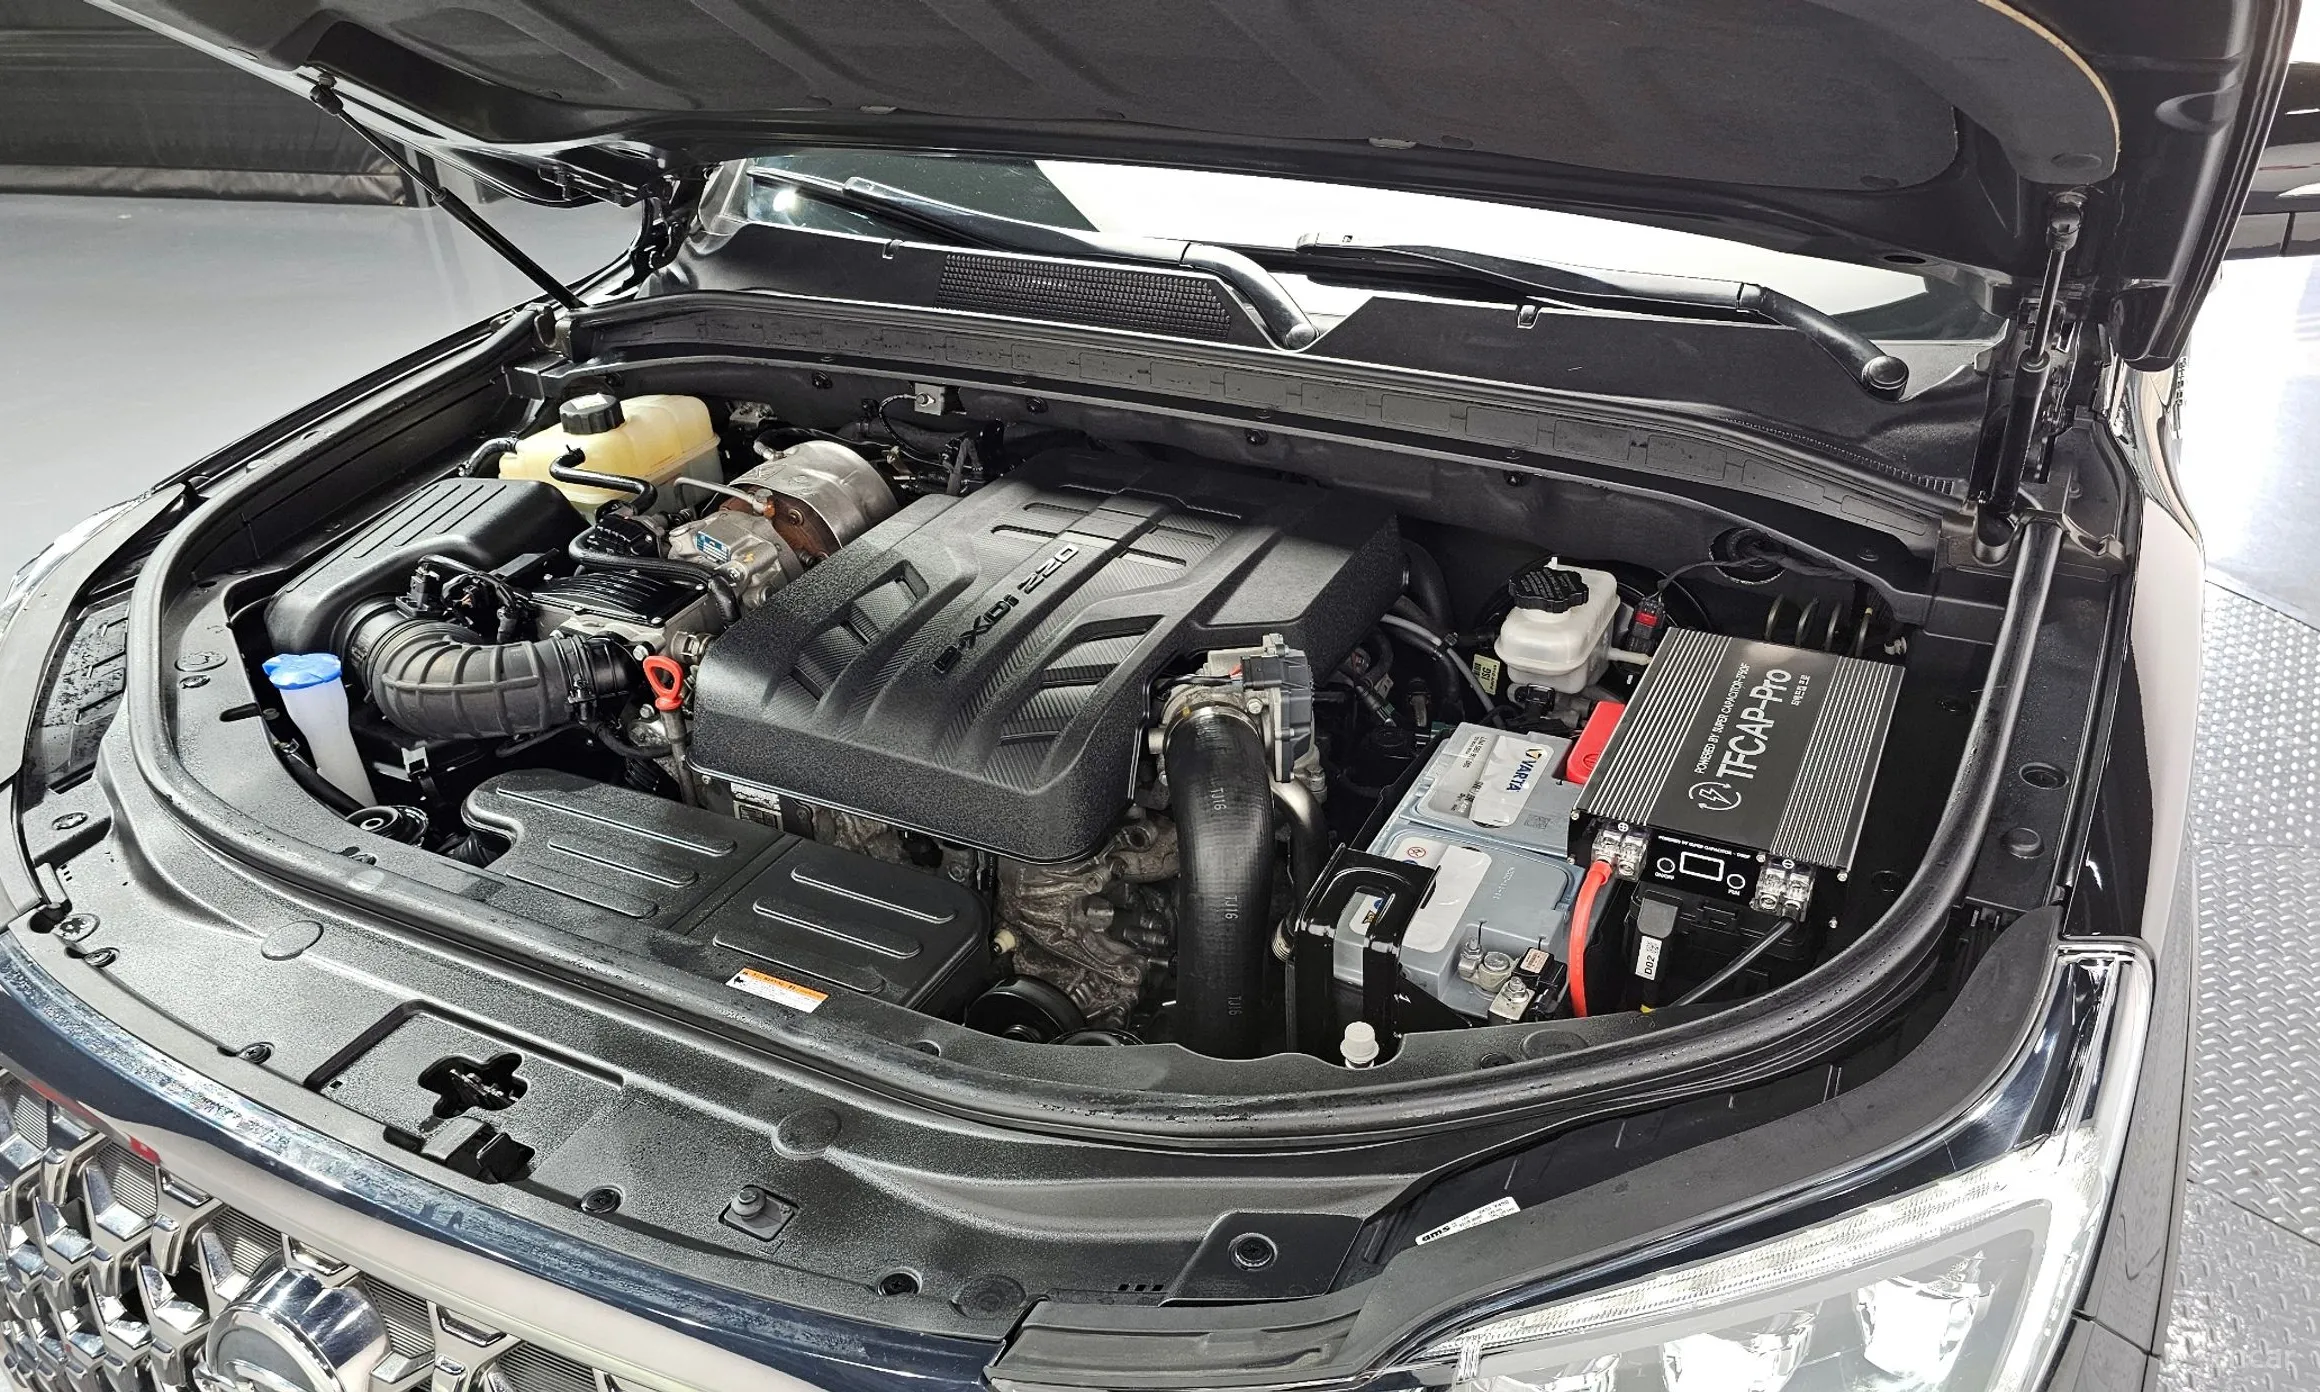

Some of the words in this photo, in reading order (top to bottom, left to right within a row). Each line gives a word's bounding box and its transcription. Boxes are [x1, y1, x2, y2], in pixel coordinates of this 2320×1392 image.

[1017, 543, 1080, 594] 220
[1711, 713, 1730, 734] SUPER
[1715, 669, 1792, 779] TFCAP-Pro
[1708, 732, 1720, 744] BY
[1693, 743, 1716, 775] POWERED
[1506, 760, 1538, 792] VARTA
[1210, 787, 1227, 811] TJ16
[1225, 895, 1238, 920] TJ16
[1228, 995, 1243, 1017] TJ16
[1422, 1225, 1451, 1242] ams
